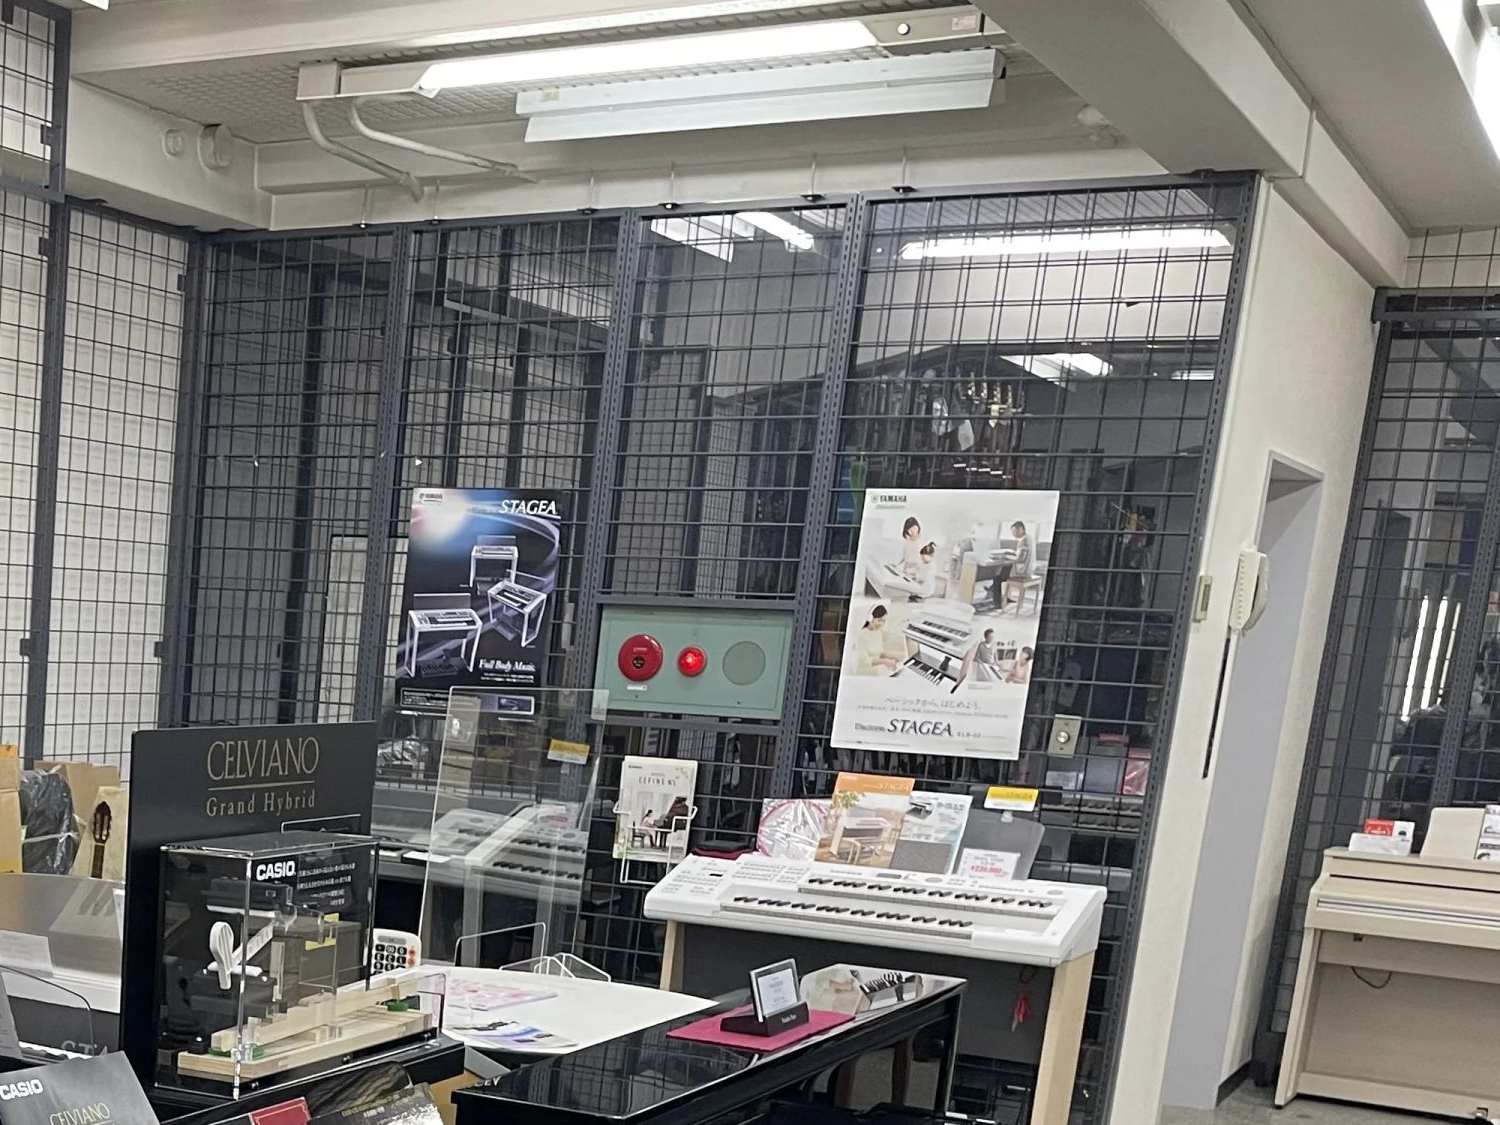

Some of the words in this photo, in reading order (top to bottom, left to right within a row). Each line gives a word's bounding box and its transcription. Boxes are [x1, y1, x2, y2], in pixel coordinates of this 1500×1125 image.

[499, 500, 557, 514] STAGEA
[880, 495, 907, 503] YAMAHA
[887, 718, 953, 737] STAGEA
[206, 735, 320, 782] CELVIANO
[206, 796, 255, 817] Grand
[263, 788, 317, 817] Hybrid
[256, 859, 296, 882] CASIO
